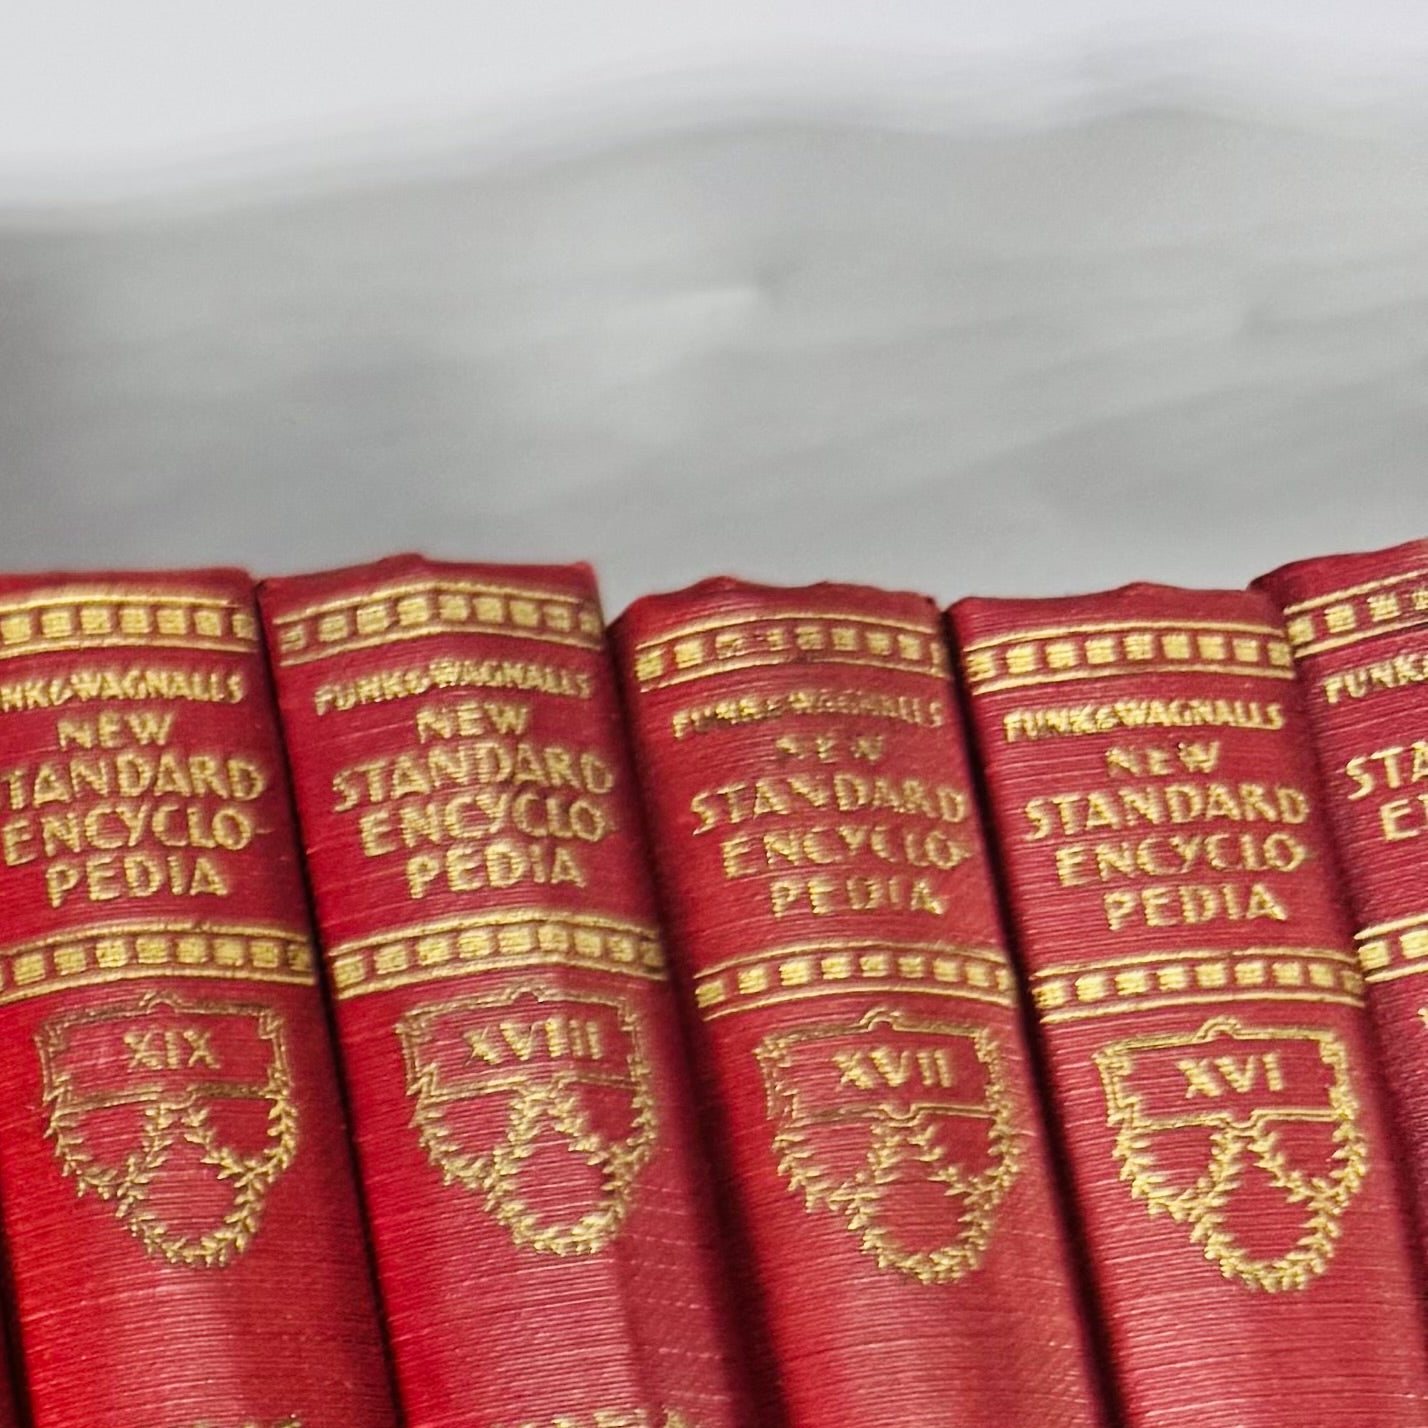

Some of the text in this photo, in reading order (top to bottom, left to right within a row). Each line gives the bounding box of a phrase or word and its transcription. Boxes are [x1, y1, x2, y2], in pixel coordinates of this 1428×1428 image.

[57, 710, 174, 751] NEW
[416, 701, 529, 744] NEW
[332, 742, 614, 813] STANDARD
[1105, 741, 1219, 778] NEW
[691, 772, 967, 836] STANDARD
[1024, 782, 1310, 841] STANDARD
[45, 855, 228, 908] PEDIA
[407, 840, 587, 900] PEDIA
[770, 876, 947, 918] PEDIA
[1102, 883, 1287, 931] PEDIA
[123, 1029, 222, 1073] XIX
[463, 1016, 603, 1067] XVIII
[832, 1046, 954, 1091] XVII
[1177, 1051, 1284, 1099] XVI
